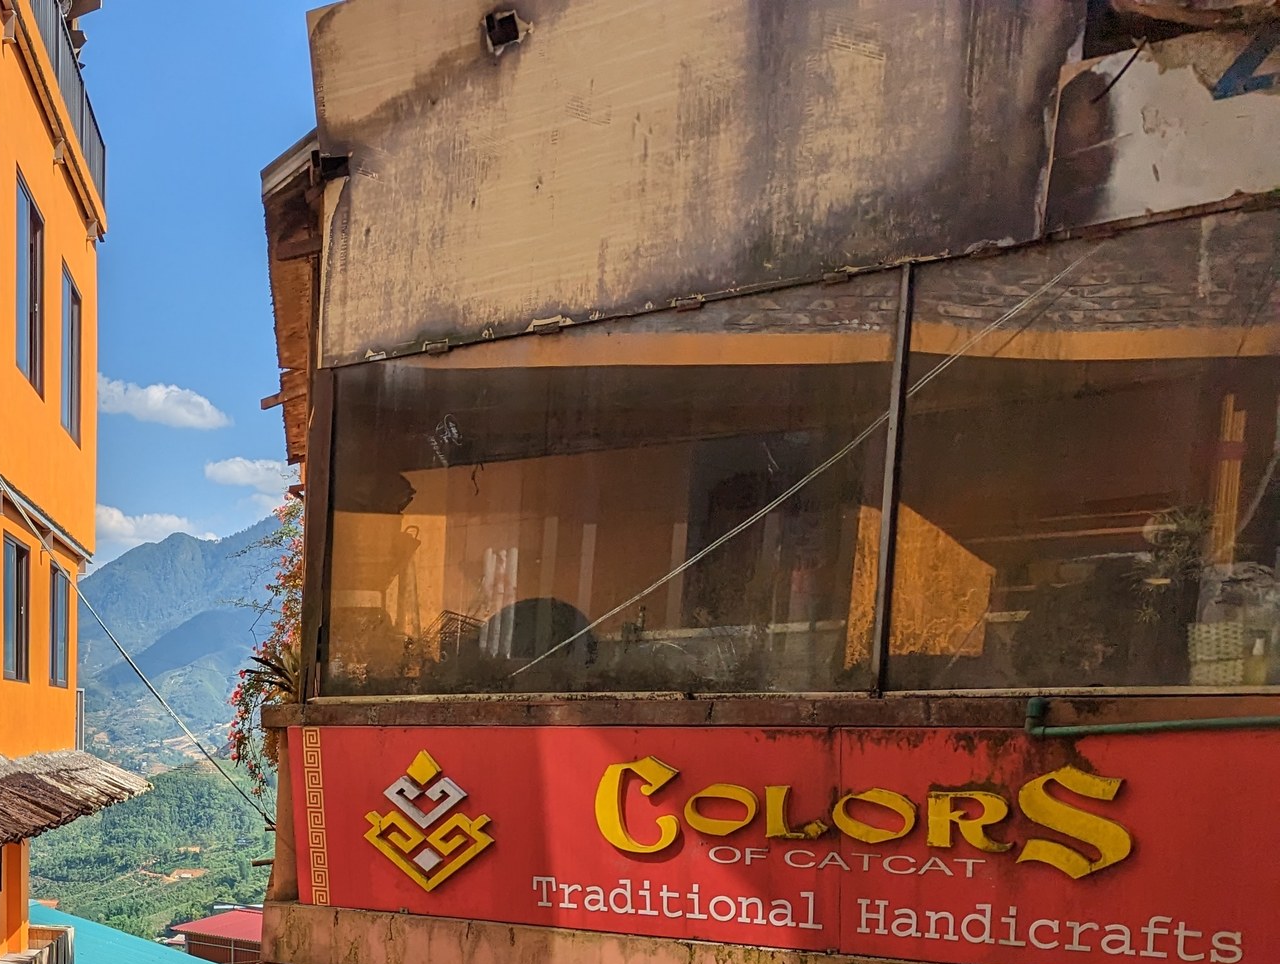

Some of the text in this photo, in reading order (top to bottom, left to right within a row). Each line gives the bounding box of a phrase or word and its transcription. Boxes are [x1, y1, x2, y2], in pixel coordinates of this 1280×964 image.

[595, 755, 1136, 880] COLORS
[708, 845, 987, 877] OF CATCAT
[532, 876, 1244, 964] Traditional Handicrafts
